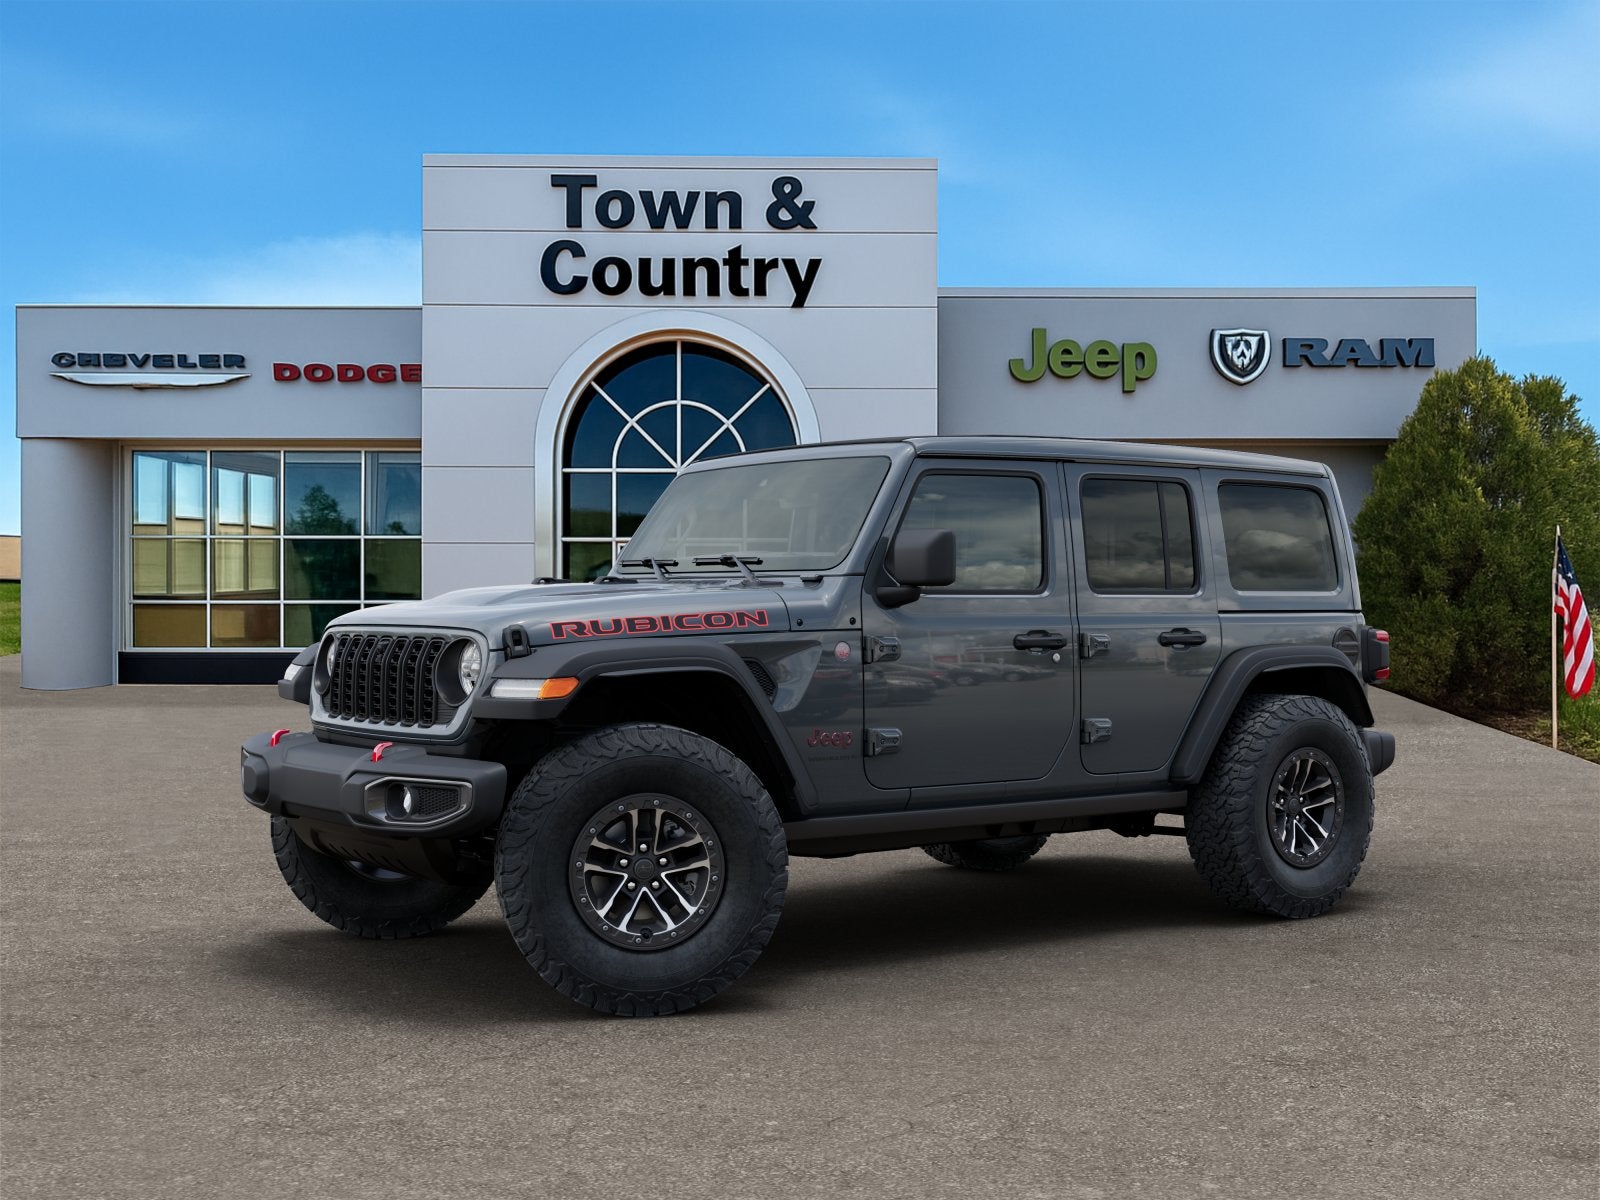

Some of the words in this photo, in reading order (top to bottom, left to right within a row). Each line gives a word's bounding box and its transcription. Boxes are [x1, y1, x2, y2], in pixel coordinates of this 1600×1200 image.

[550, 174, 743, 230] Town
[765, 175, 819, 230] &
[539, 239, 822, 308] Country
[1009, 328, 1158, 393] Jeep
[1283, 337, 1436, 368] RAM
[273, 362, 422, 383] DODGE
[550, 609, 769, 639] RUBICON
[807, 728, 853, 751] Jeep
